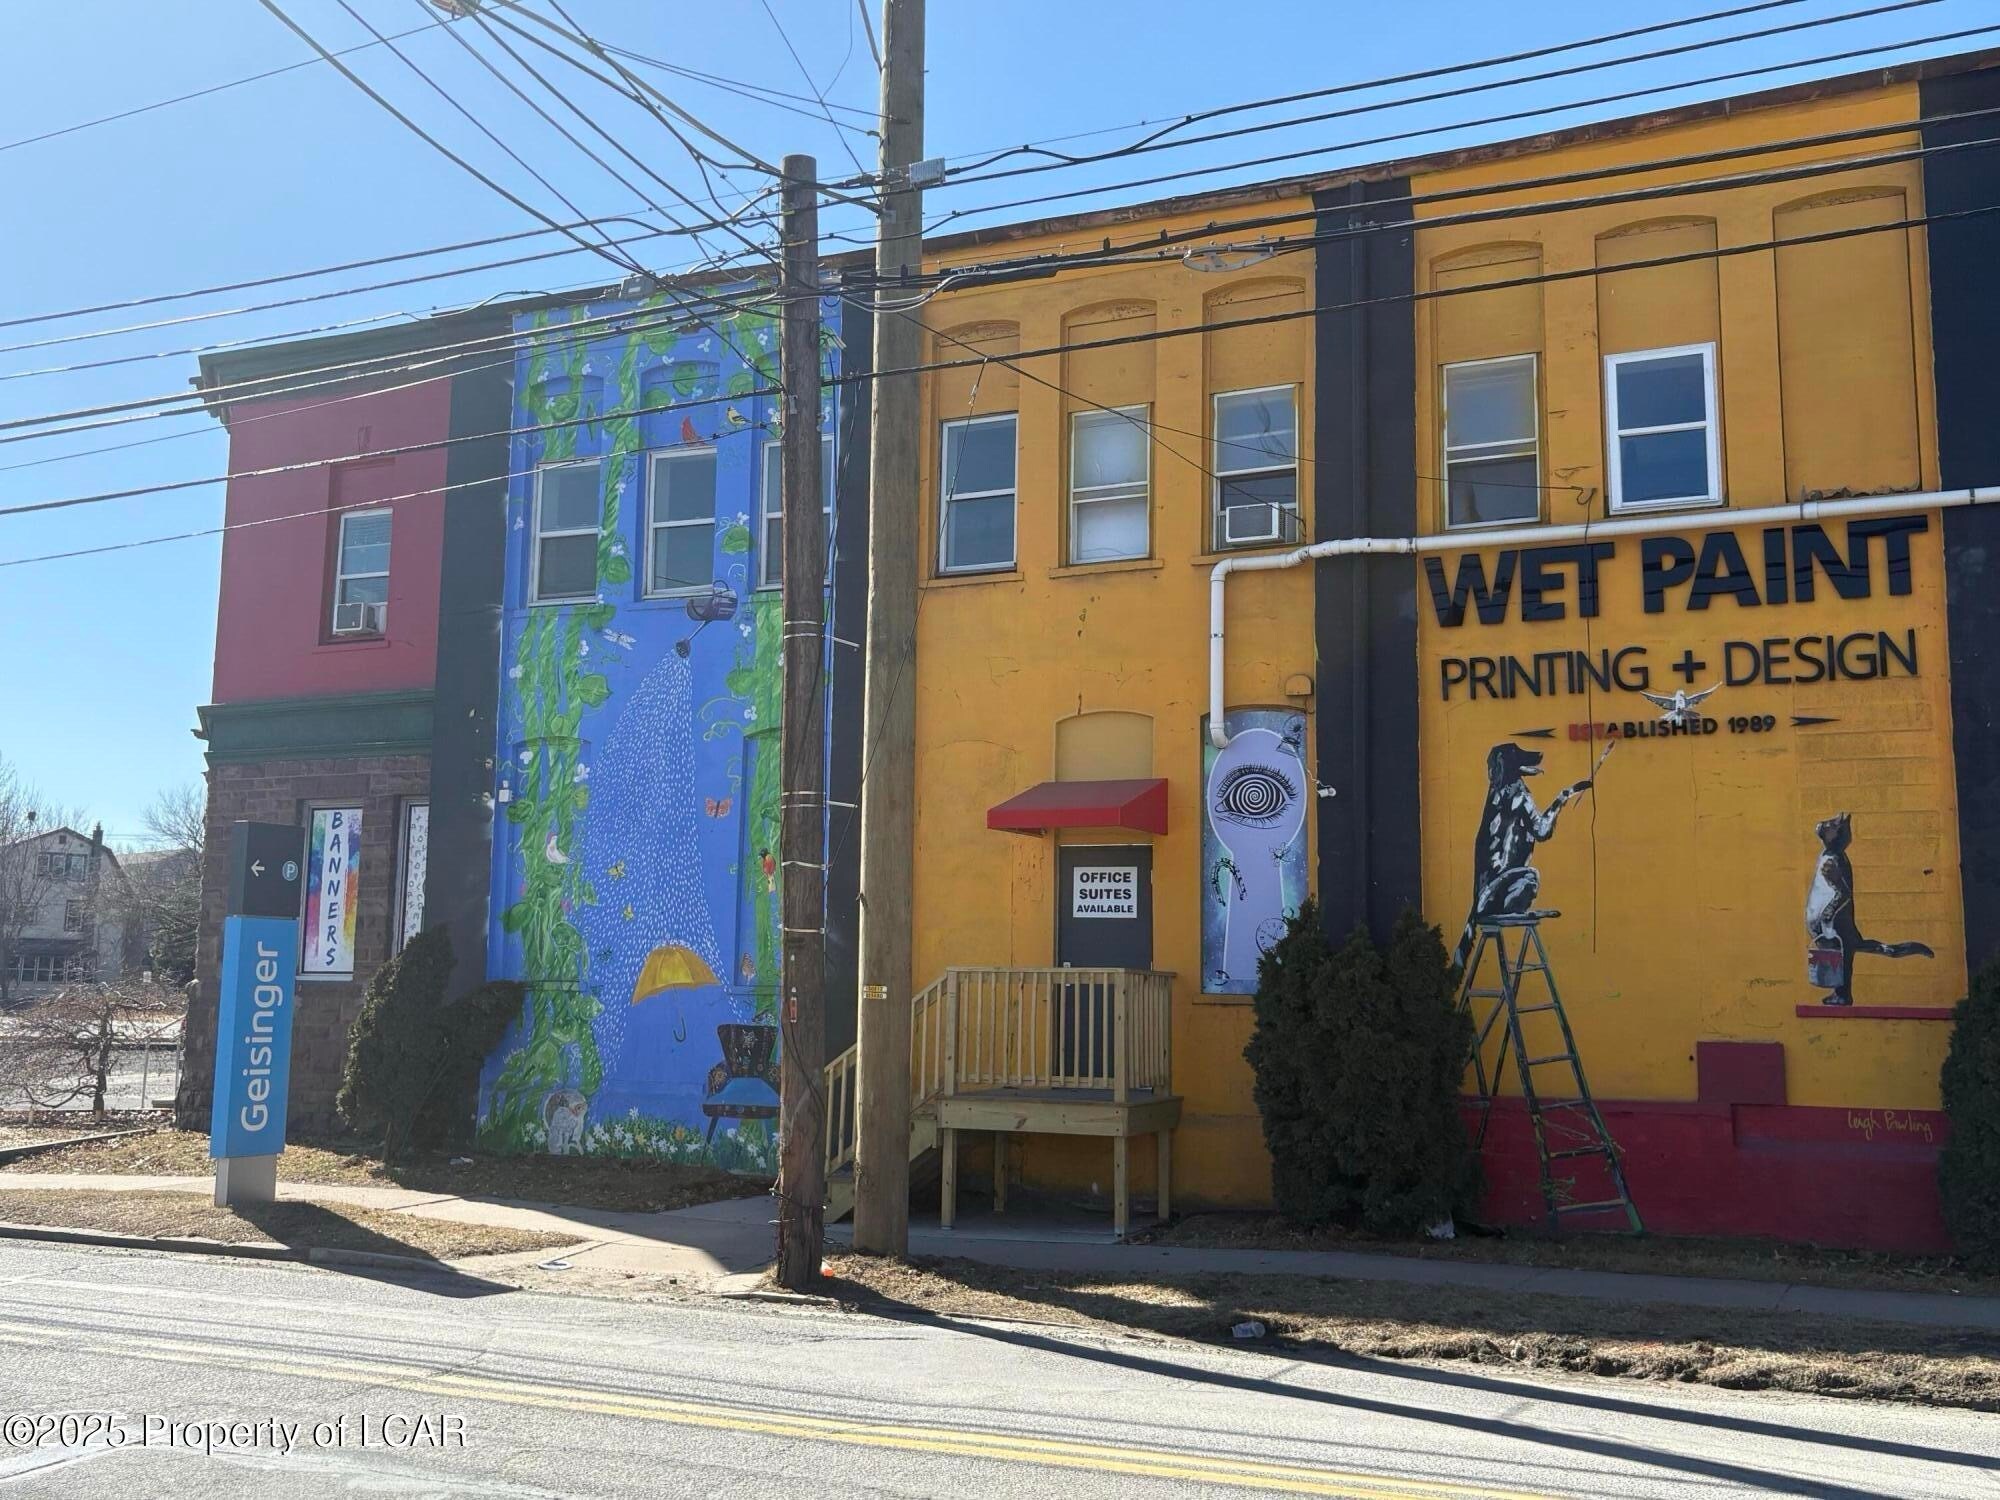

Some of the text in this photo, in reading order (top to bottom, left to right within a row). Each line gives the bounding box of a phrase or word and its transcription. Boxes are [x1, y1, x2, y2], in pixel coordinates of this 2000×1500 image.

[1423, 514, 1929, 628] WET PAINT
[1440, 646, 1649, 701] PRINTING
[1724, 628, 1918, 687] DESIGN
[1728, 714, 1776, 734] 1989
[325, 811, 344, 966] BANNERS
[1079, 889, 1132, 900] SUITES
[1080, 872, 1132, 883] OFFICE
[1076, 905, 1134, 913] AVAILABLE
[240, 941, 284, 1132] Geisinger
